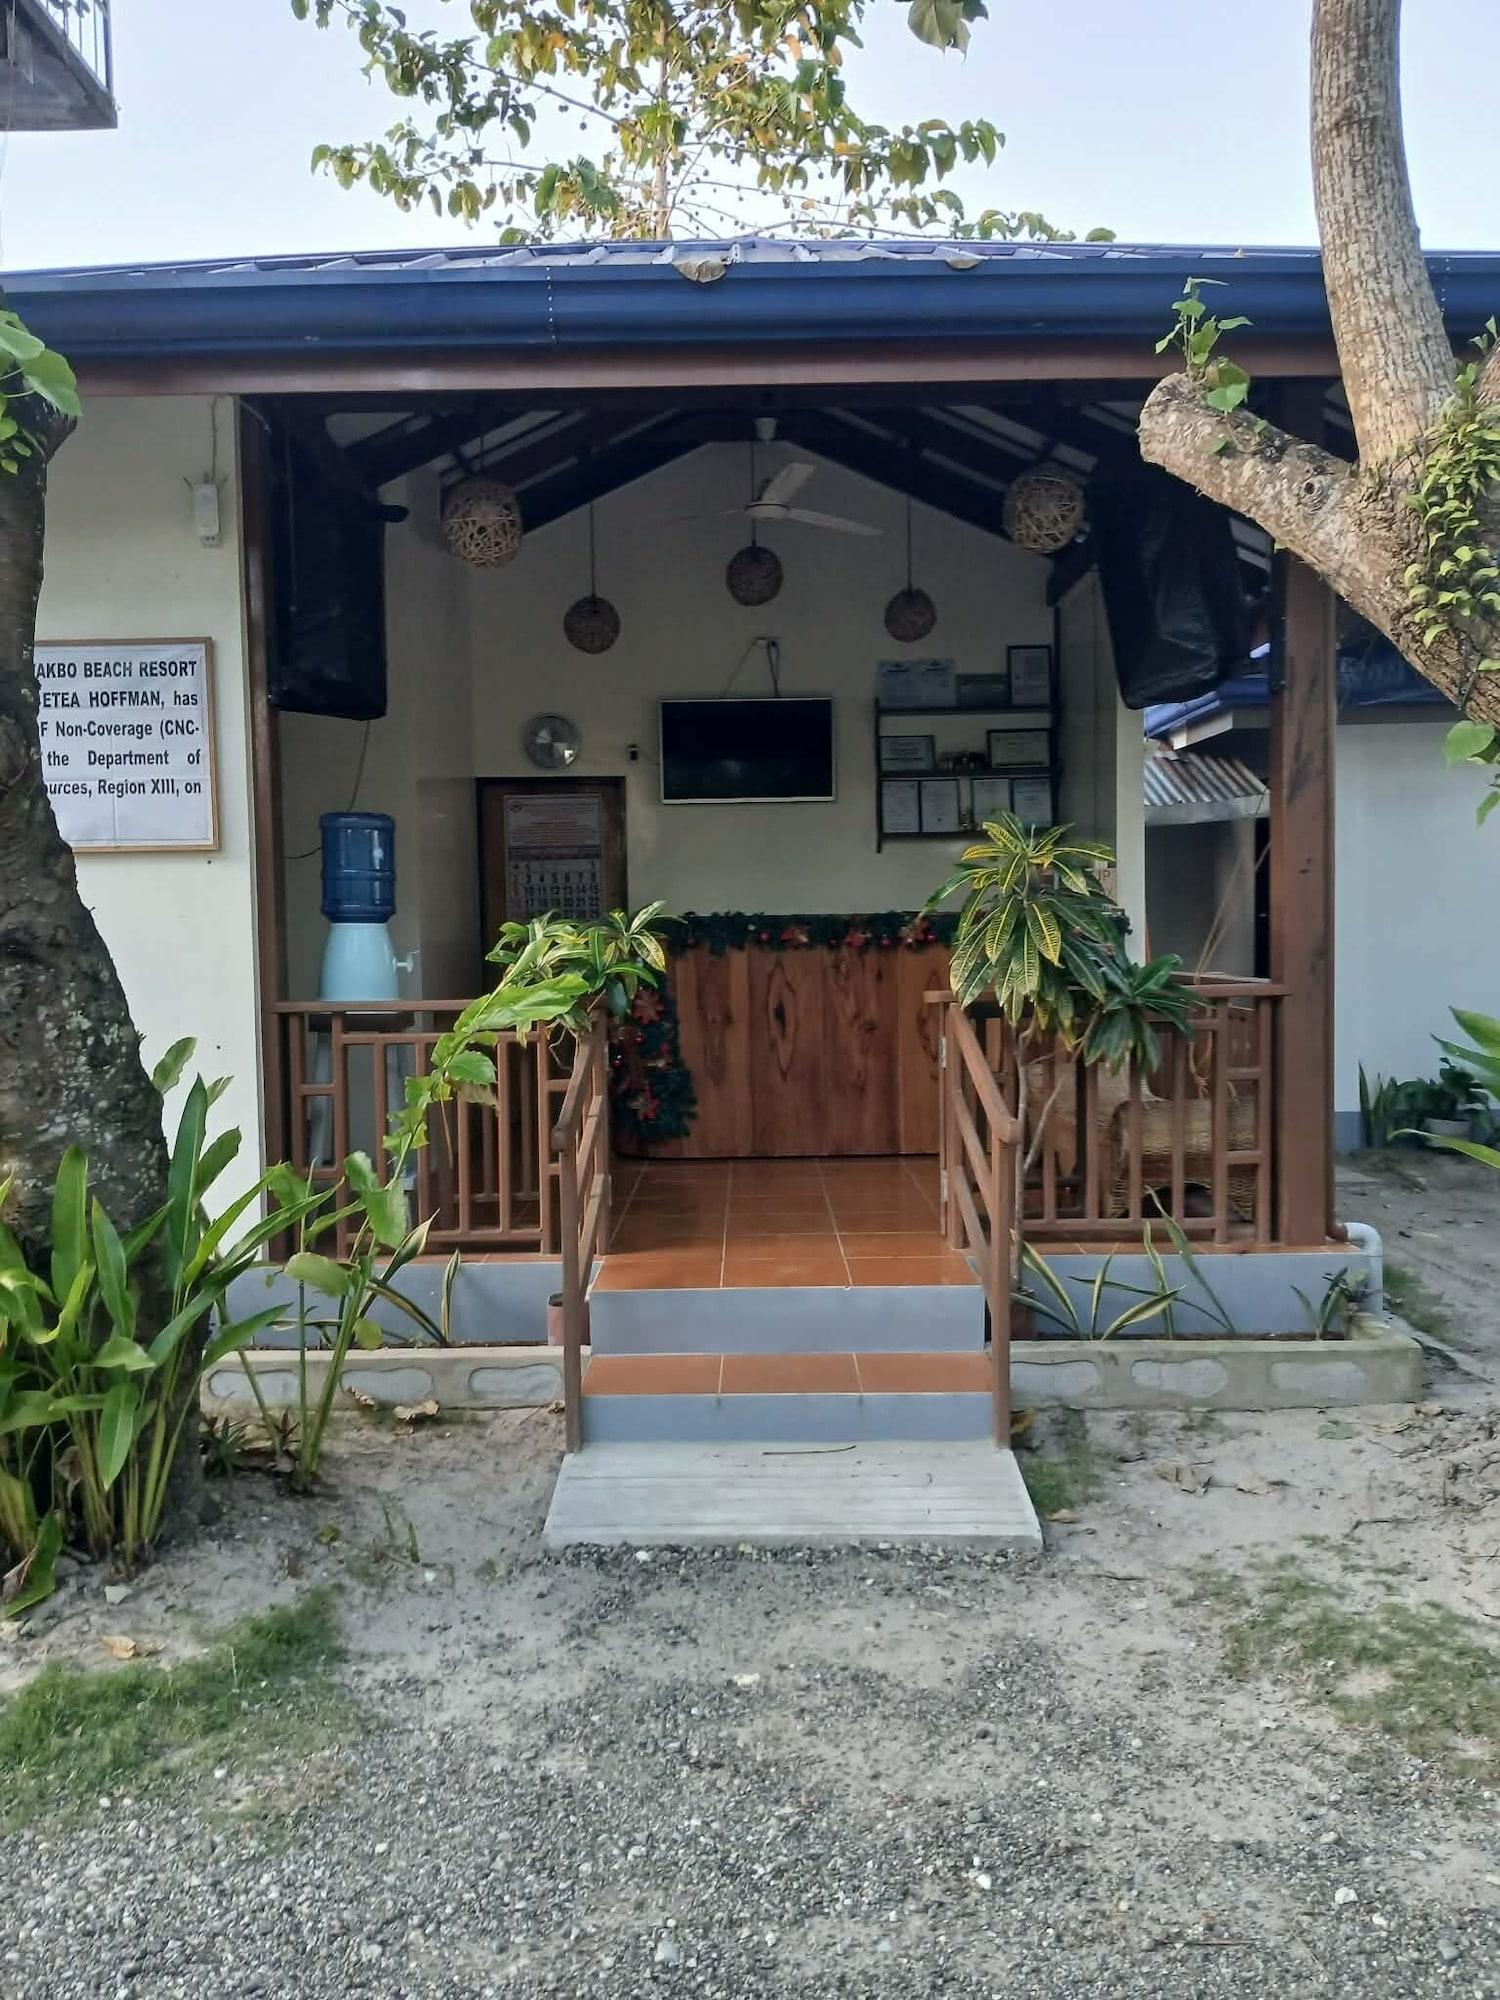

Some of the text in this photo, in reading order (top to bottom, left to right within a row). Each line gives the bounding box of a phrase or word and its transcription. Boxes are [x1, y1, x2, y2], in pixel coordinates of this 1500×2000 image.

[84, 662, 132, 678] BEACH
[140, 661, 197, 677] RESORT
[42, 691, 197, 709] ETEA HOFFMAN, has
[40, 720, 199, 739] F Non-Coverage (CNC-
[47, 749, 200, 769] the Department of
[98, 779, 145, 798] Region
[151, 779, 179, 797] XIII,
[185, 782, 201, 793] on
